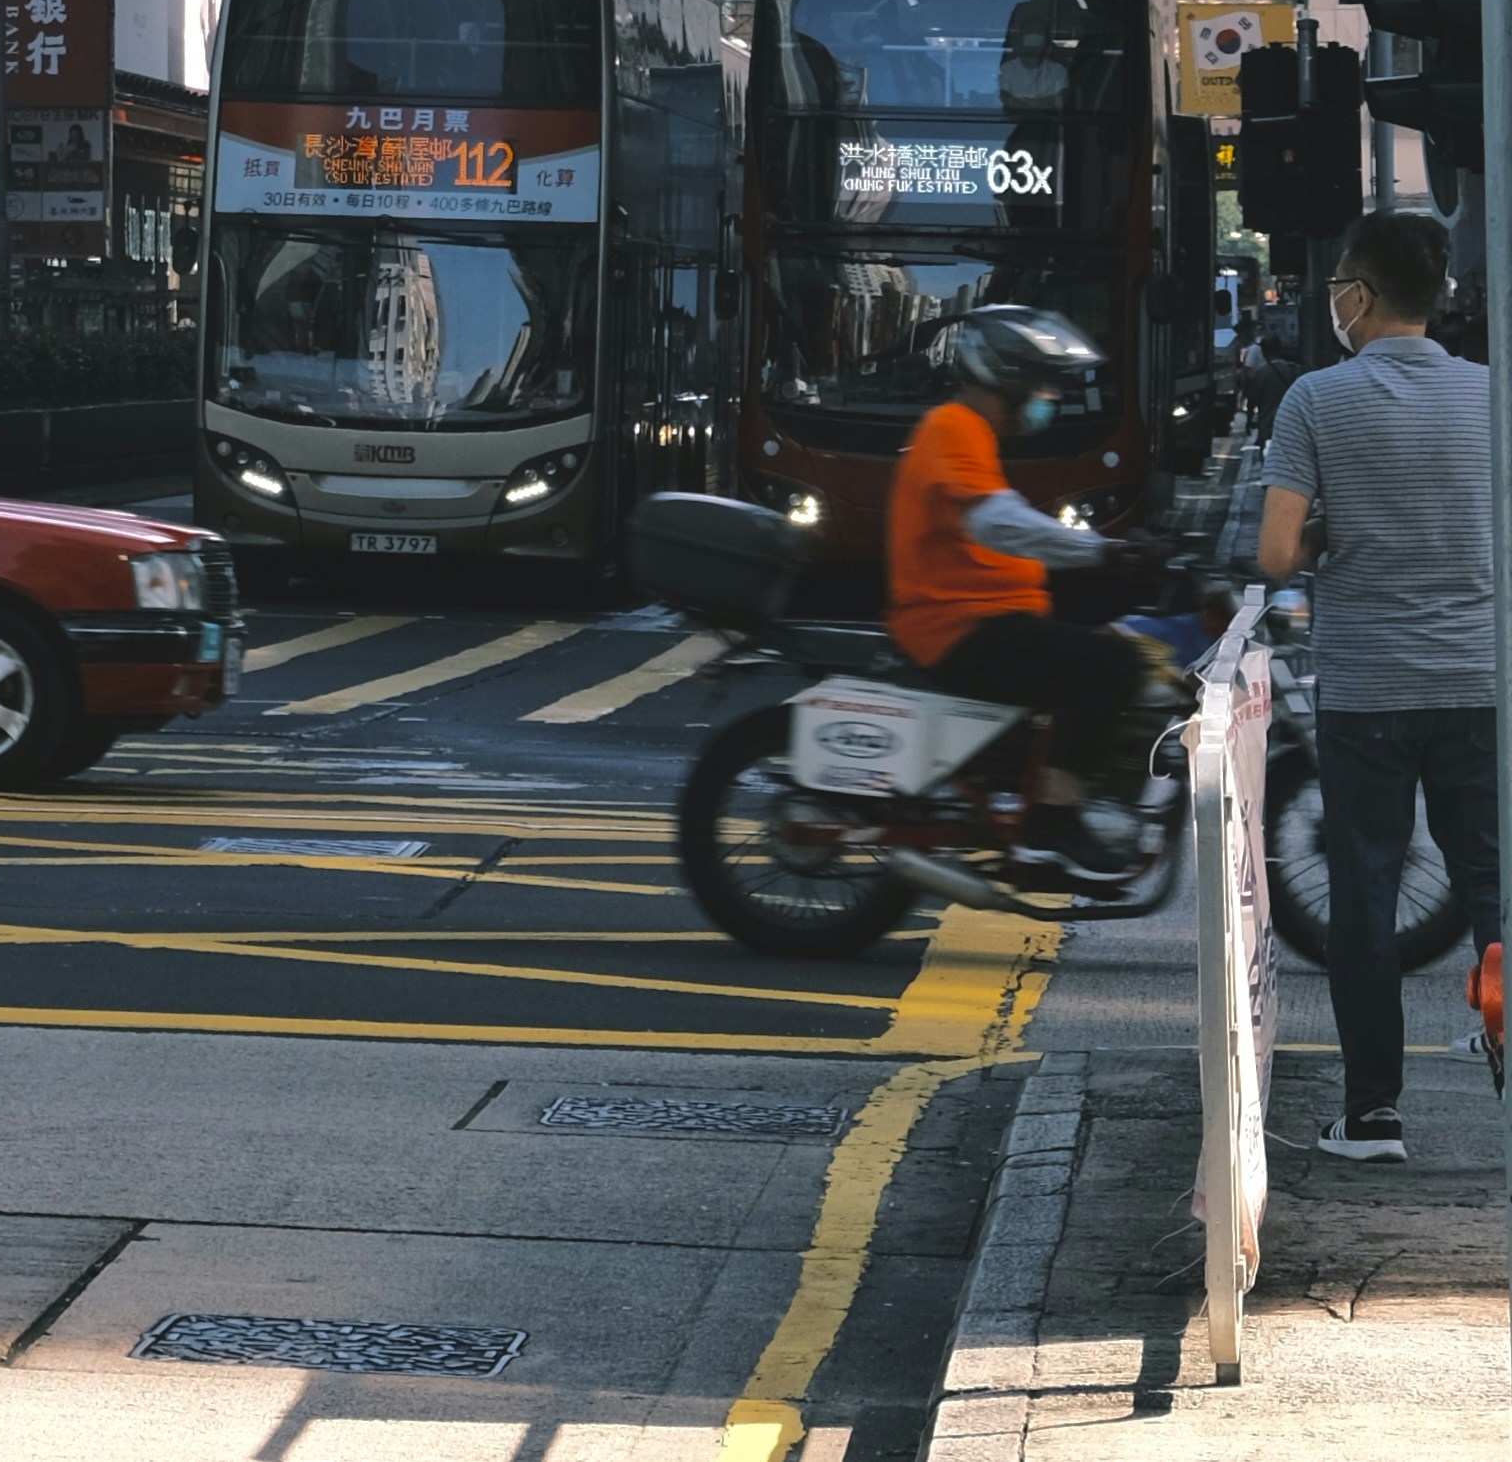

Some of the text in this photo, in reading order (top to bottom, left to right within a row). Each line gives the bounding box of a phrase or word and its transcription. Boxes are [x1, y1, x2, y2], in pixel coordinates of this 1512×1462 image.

[5, 5, 20, 75] BANK
[346, 106, 470, 133] 九巴月票
[453, 141, 514, 188] 112
[839, 142, 988, 170] 洪水橋洪福邨
[407, 160, 435, 174] WAN
[861, 166, 961, 181] HUNG SHUI KIU
[536, 167, 577, 188] 化算
[888, 179, 914, 193] FUK
[263, 191, 327, 208] 30日有效
[355, 535, 431, 552] TR 3797
